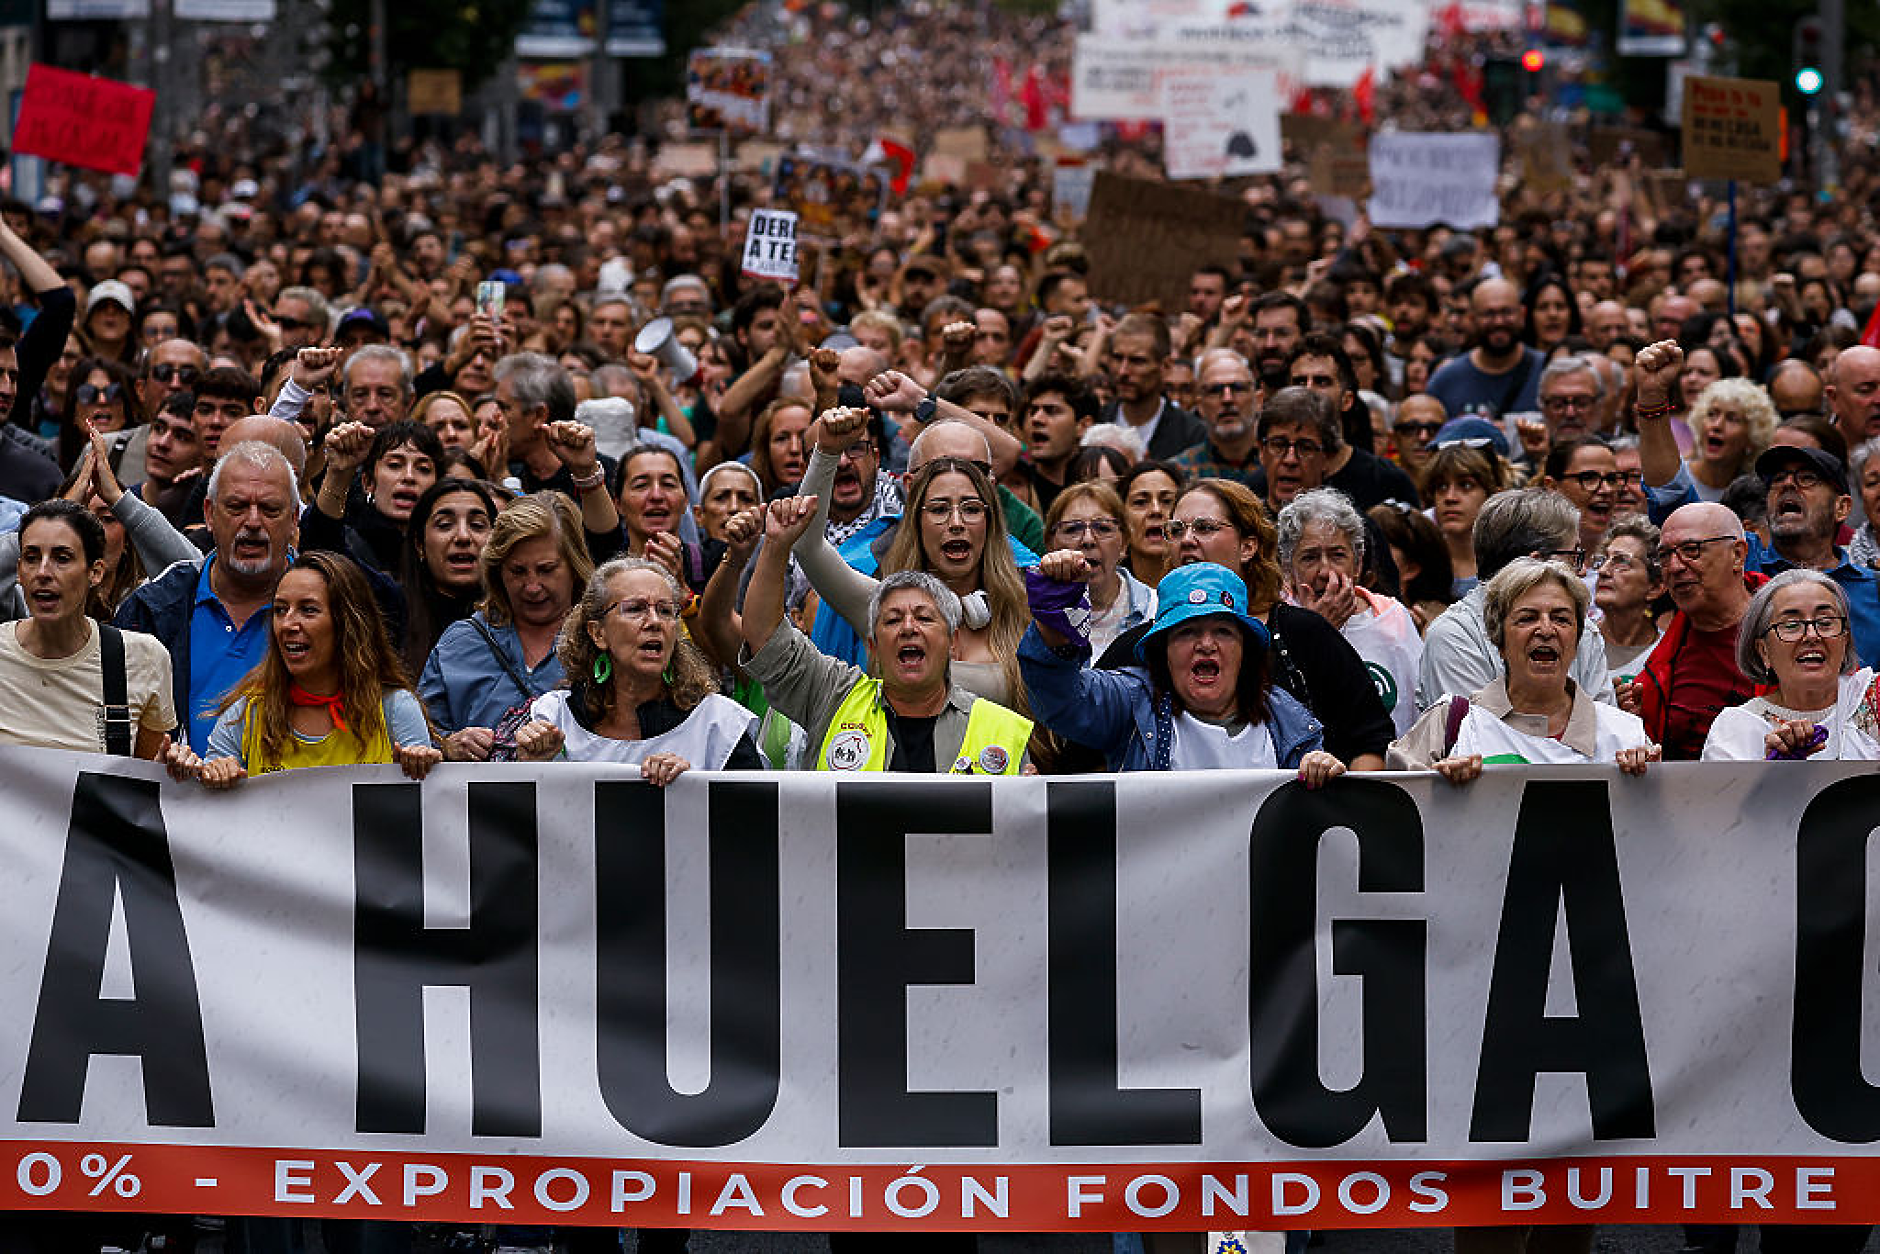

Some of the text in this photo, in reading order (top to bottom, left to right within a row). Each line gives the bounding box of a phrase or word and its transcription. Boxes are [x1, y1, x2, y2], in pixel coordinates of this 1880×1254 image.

[749, 238, 761, 257] A
[16, 770, 216, 1128] A
[352, 779, 1656, 1149] HUELGA
[275, 1160, 1009, 1218] EXPROPIACIÓN
[1068, 1171, 1449, 1217] FONDOS
[1502, 1167, 1837, 1211] BUITRE
